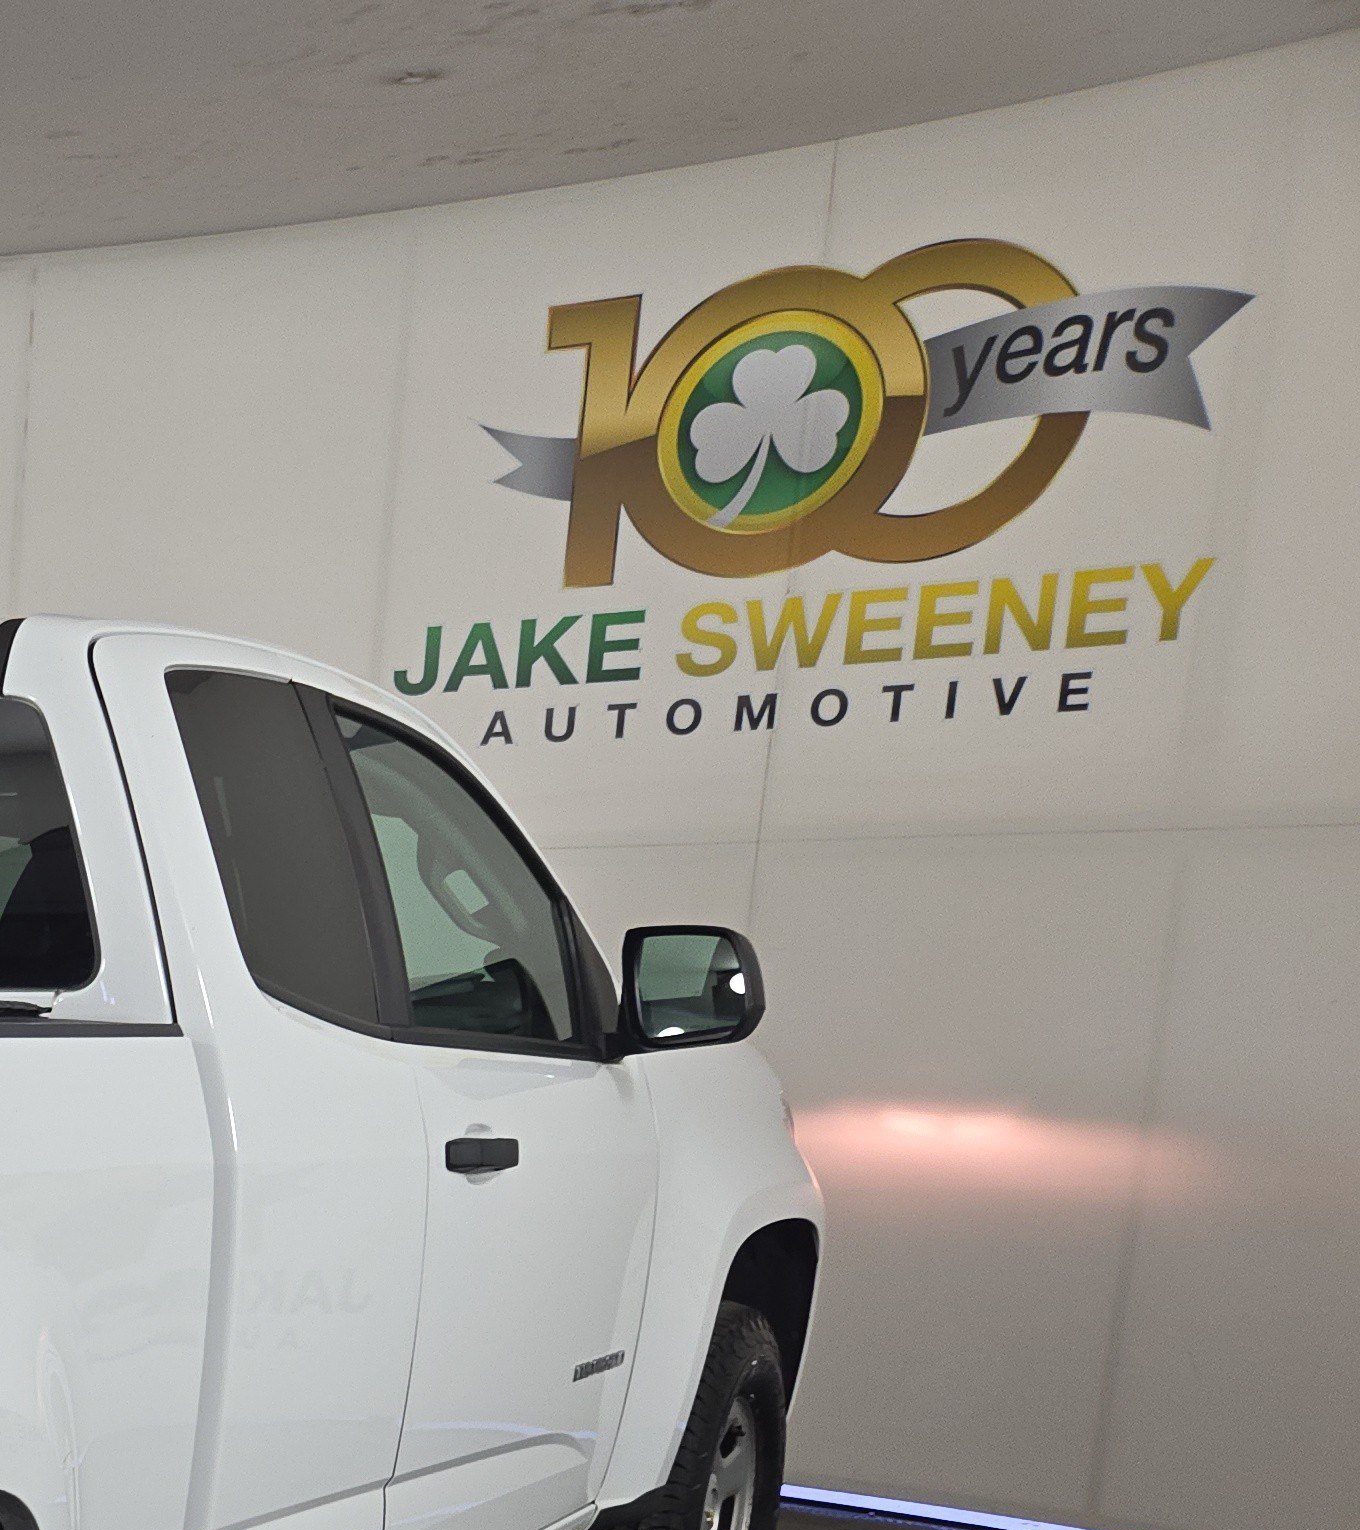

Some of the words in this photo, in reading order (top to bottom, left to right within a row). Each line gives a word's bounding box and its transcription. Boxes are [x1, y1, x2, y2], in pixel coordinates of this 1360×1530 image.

[942, 305, 1177, 418] years
[392, 609, 647, 697] JAKE
[674, 557, 1216, 678] SWEENEY
[481, 670, 1094, 746] AUTOMOTIVE
